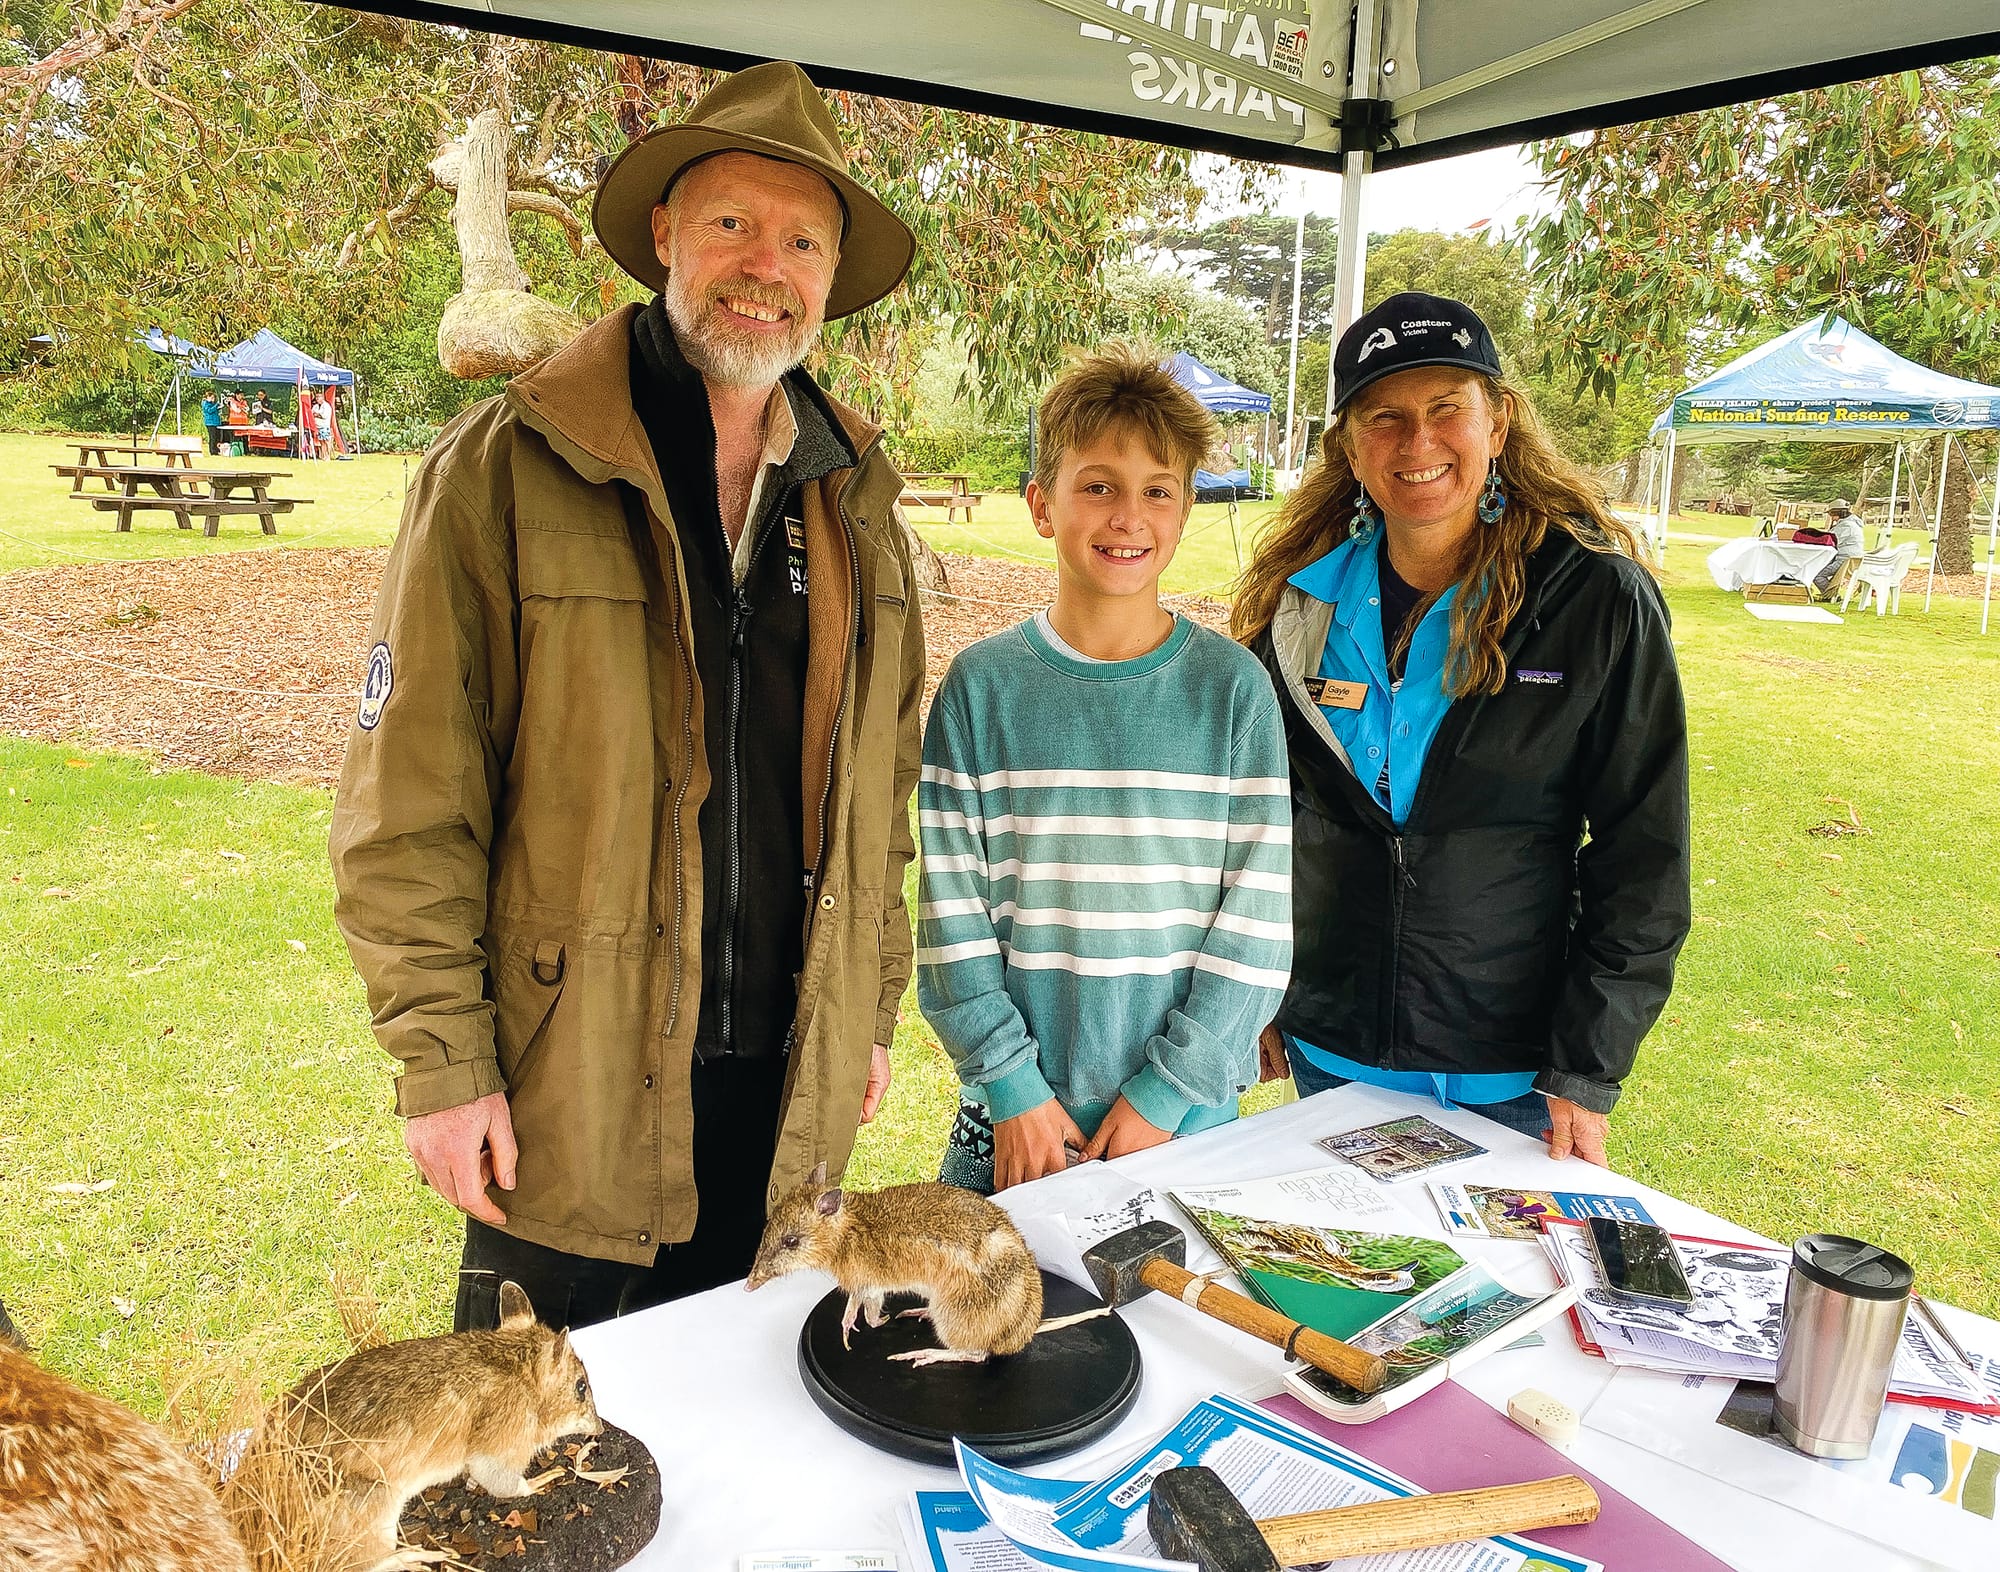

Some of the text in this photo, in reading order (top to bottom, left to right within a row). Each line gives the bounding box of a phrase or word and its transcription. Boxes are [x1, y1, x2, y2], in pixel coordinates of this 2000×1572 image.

[1401, 320, 1452, 329] Coastcare
[1403, 328, 1429, 336] Victoria
[1690, 400, 1725, 408] PHILLIP
[1801, 400, 1830, 408] protect
[1689, 408, 1910, 425] National Surfing Reserve
[1519, 676, 1558, 684] patagonia
[1327, 684, 1350, 697] Gayle
[1942, 1409, 1964, 1433] BAY
